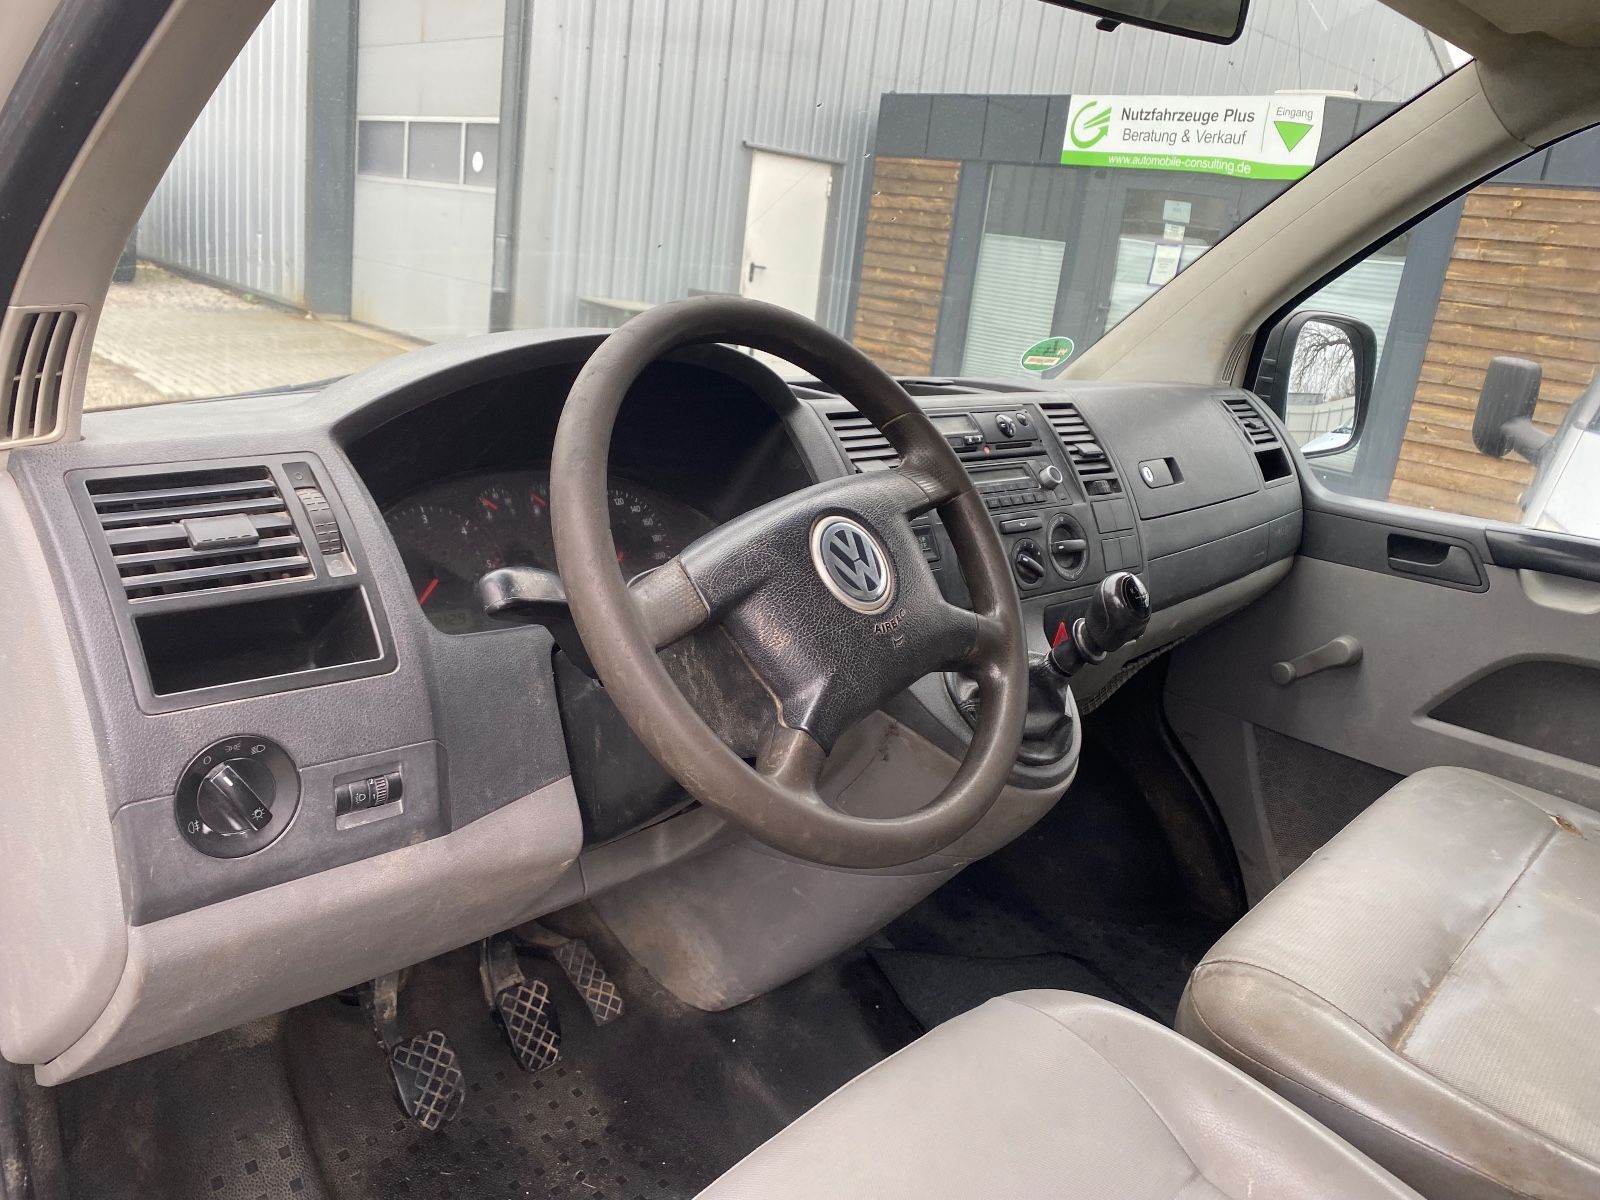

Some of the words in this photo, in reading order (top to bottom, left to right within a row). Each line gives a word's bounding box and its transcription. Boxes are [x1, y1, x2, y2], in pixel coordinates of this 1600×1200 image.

[1121, 107, 1219, 125] Nutzfahrzeuge
[1223, 108, 1255, 122] Plus
[1276, 106, 1313, 120] Eingang
[1122, 128, 1177, 146] Beratung
[1181, 129, 1191, 143] &
[1196, 129, 1248, 145] Verkauf
[1108, 155, 1252, 175] www.automobile-consulting.de
